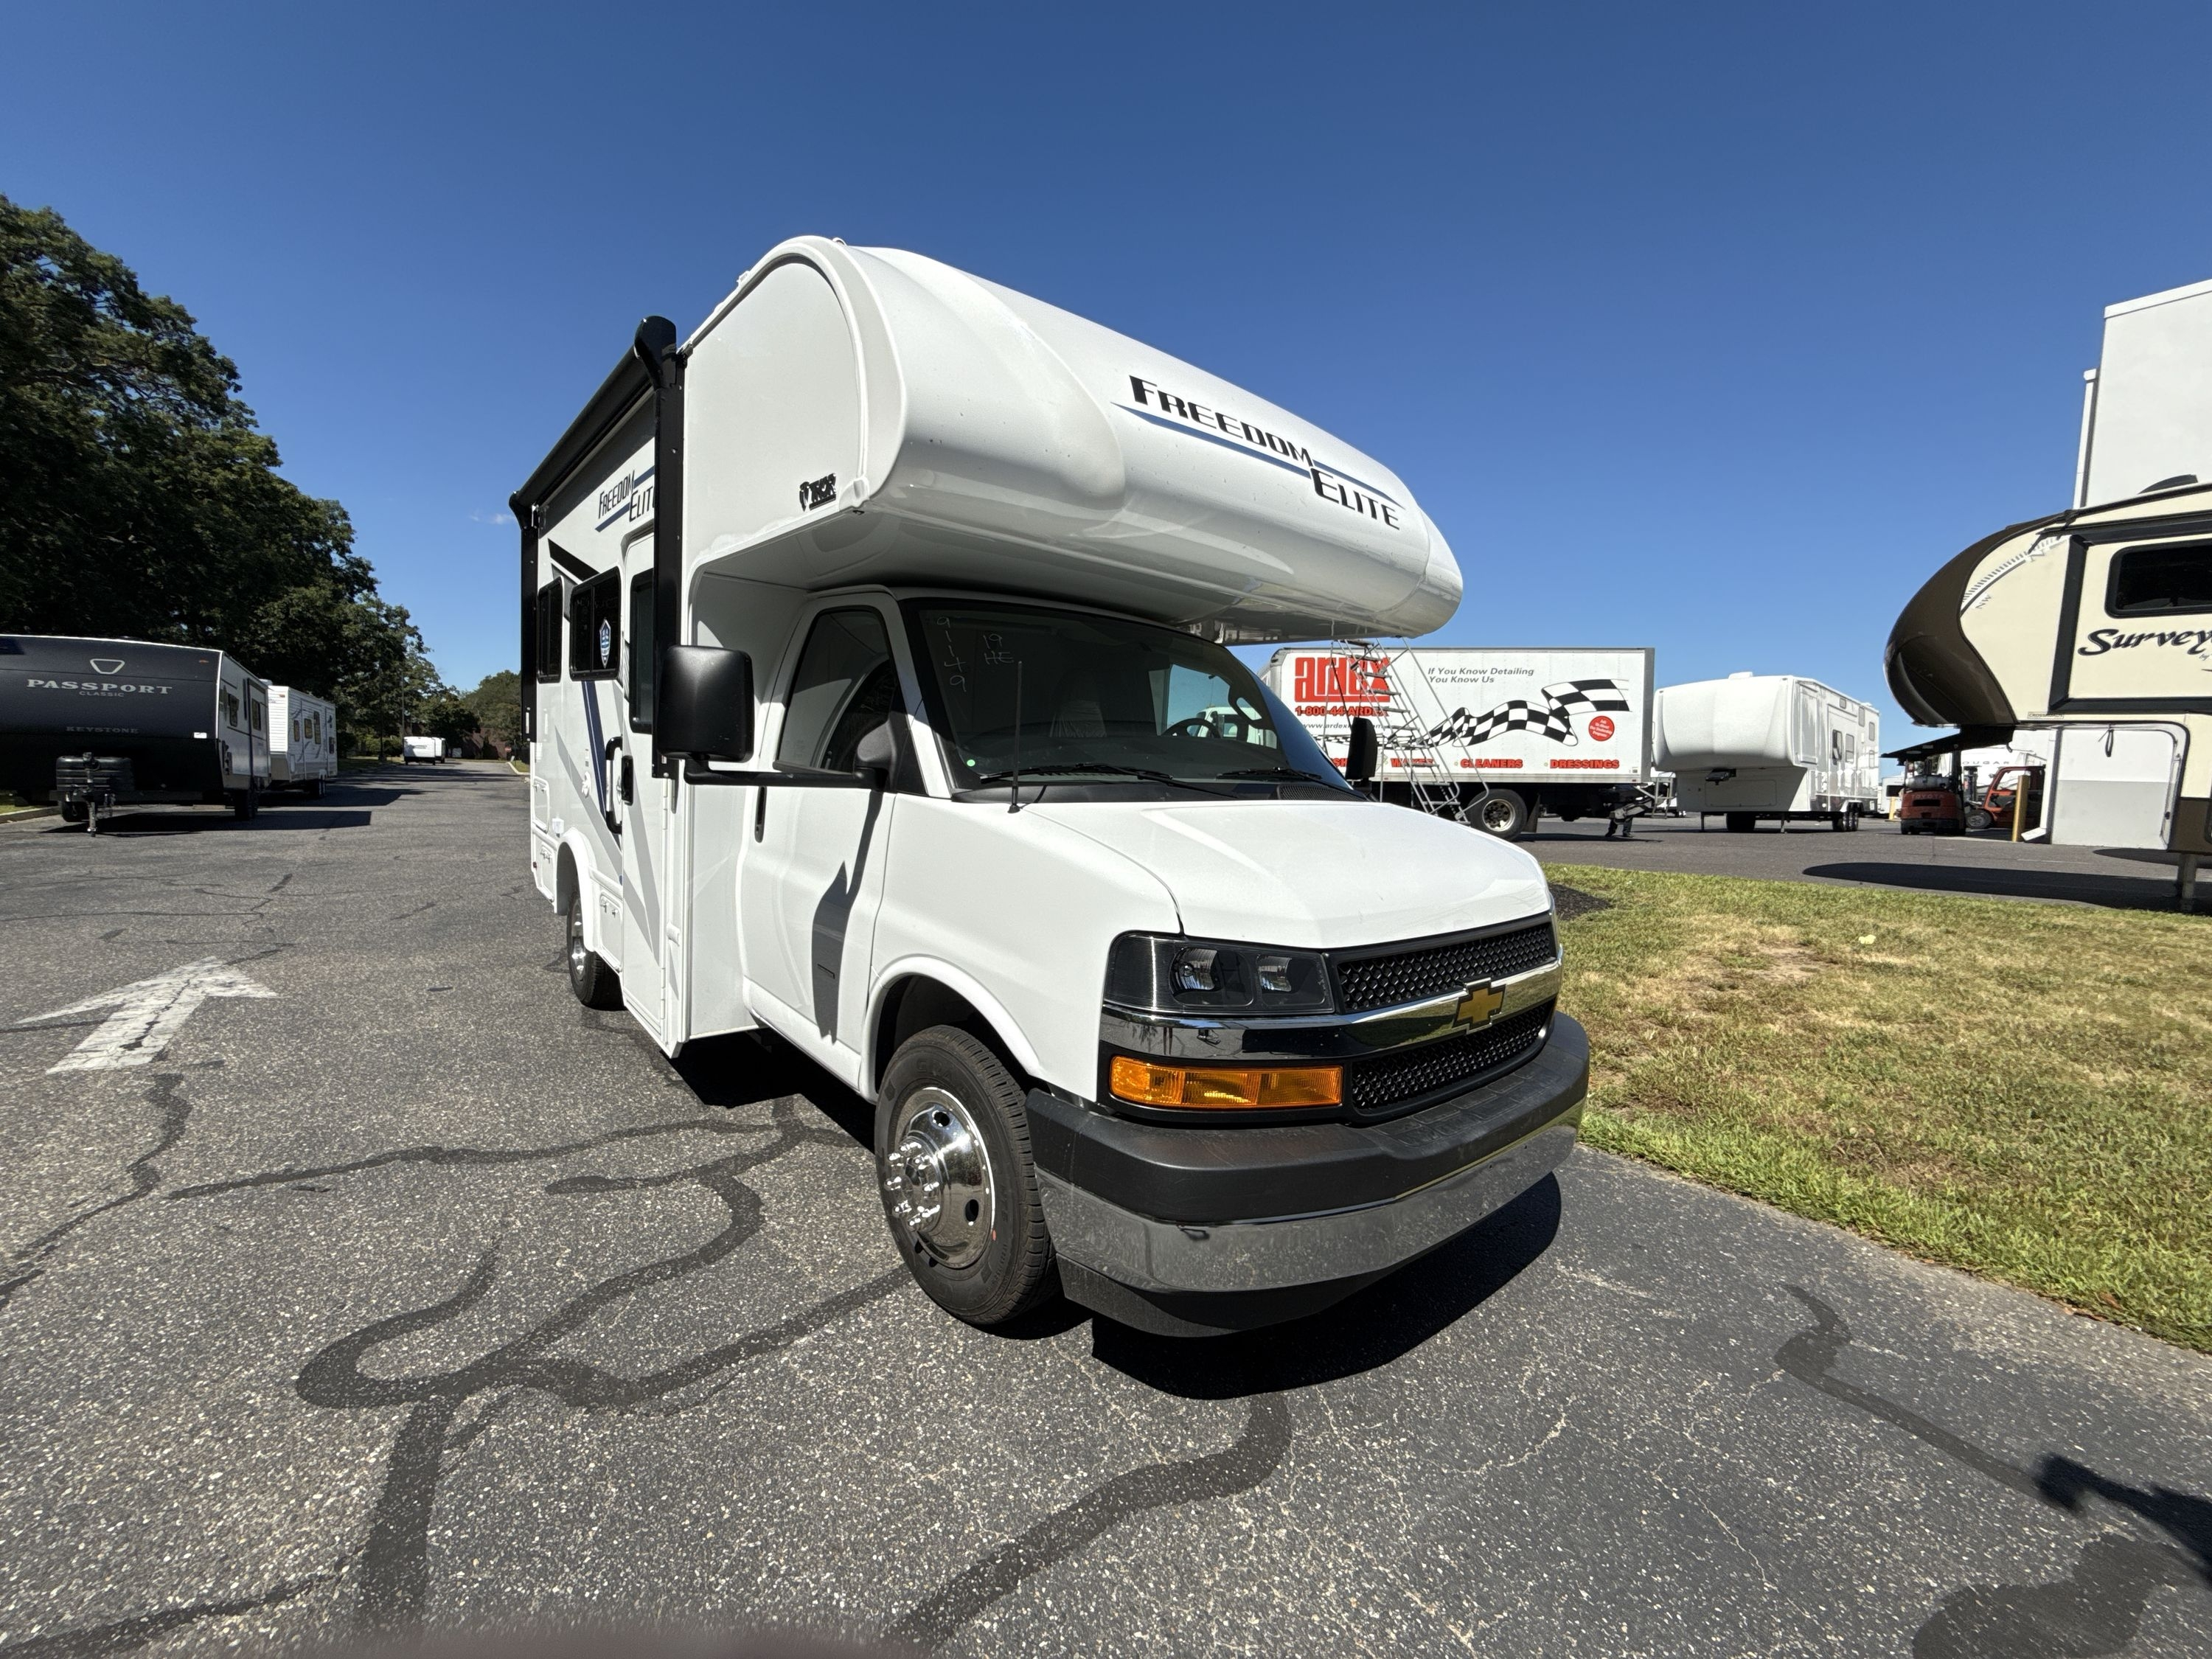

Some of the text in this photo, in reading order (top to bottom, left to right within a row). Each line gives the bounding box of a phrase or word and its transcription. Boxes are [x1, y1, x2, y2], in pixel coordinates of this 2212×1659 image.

[1129, 375, 1314, 467] FREEDOM
[598, 470, 635, 519] FREEDOM
[1310, 467, 1400, 531] ELITE
[2077, 629, 2212, 655] Survey
[1481, 675, 1495, 684] Us
[1490, 667, 1534, 677] Detailing
[27, 678, 173, 694] PASSPORT
[65, 726, 139, 734] KEYSTONE
[1460, 759, 1523, 769] CLEANERS
[1549, 759, 1620, 769] DRESSINGS
